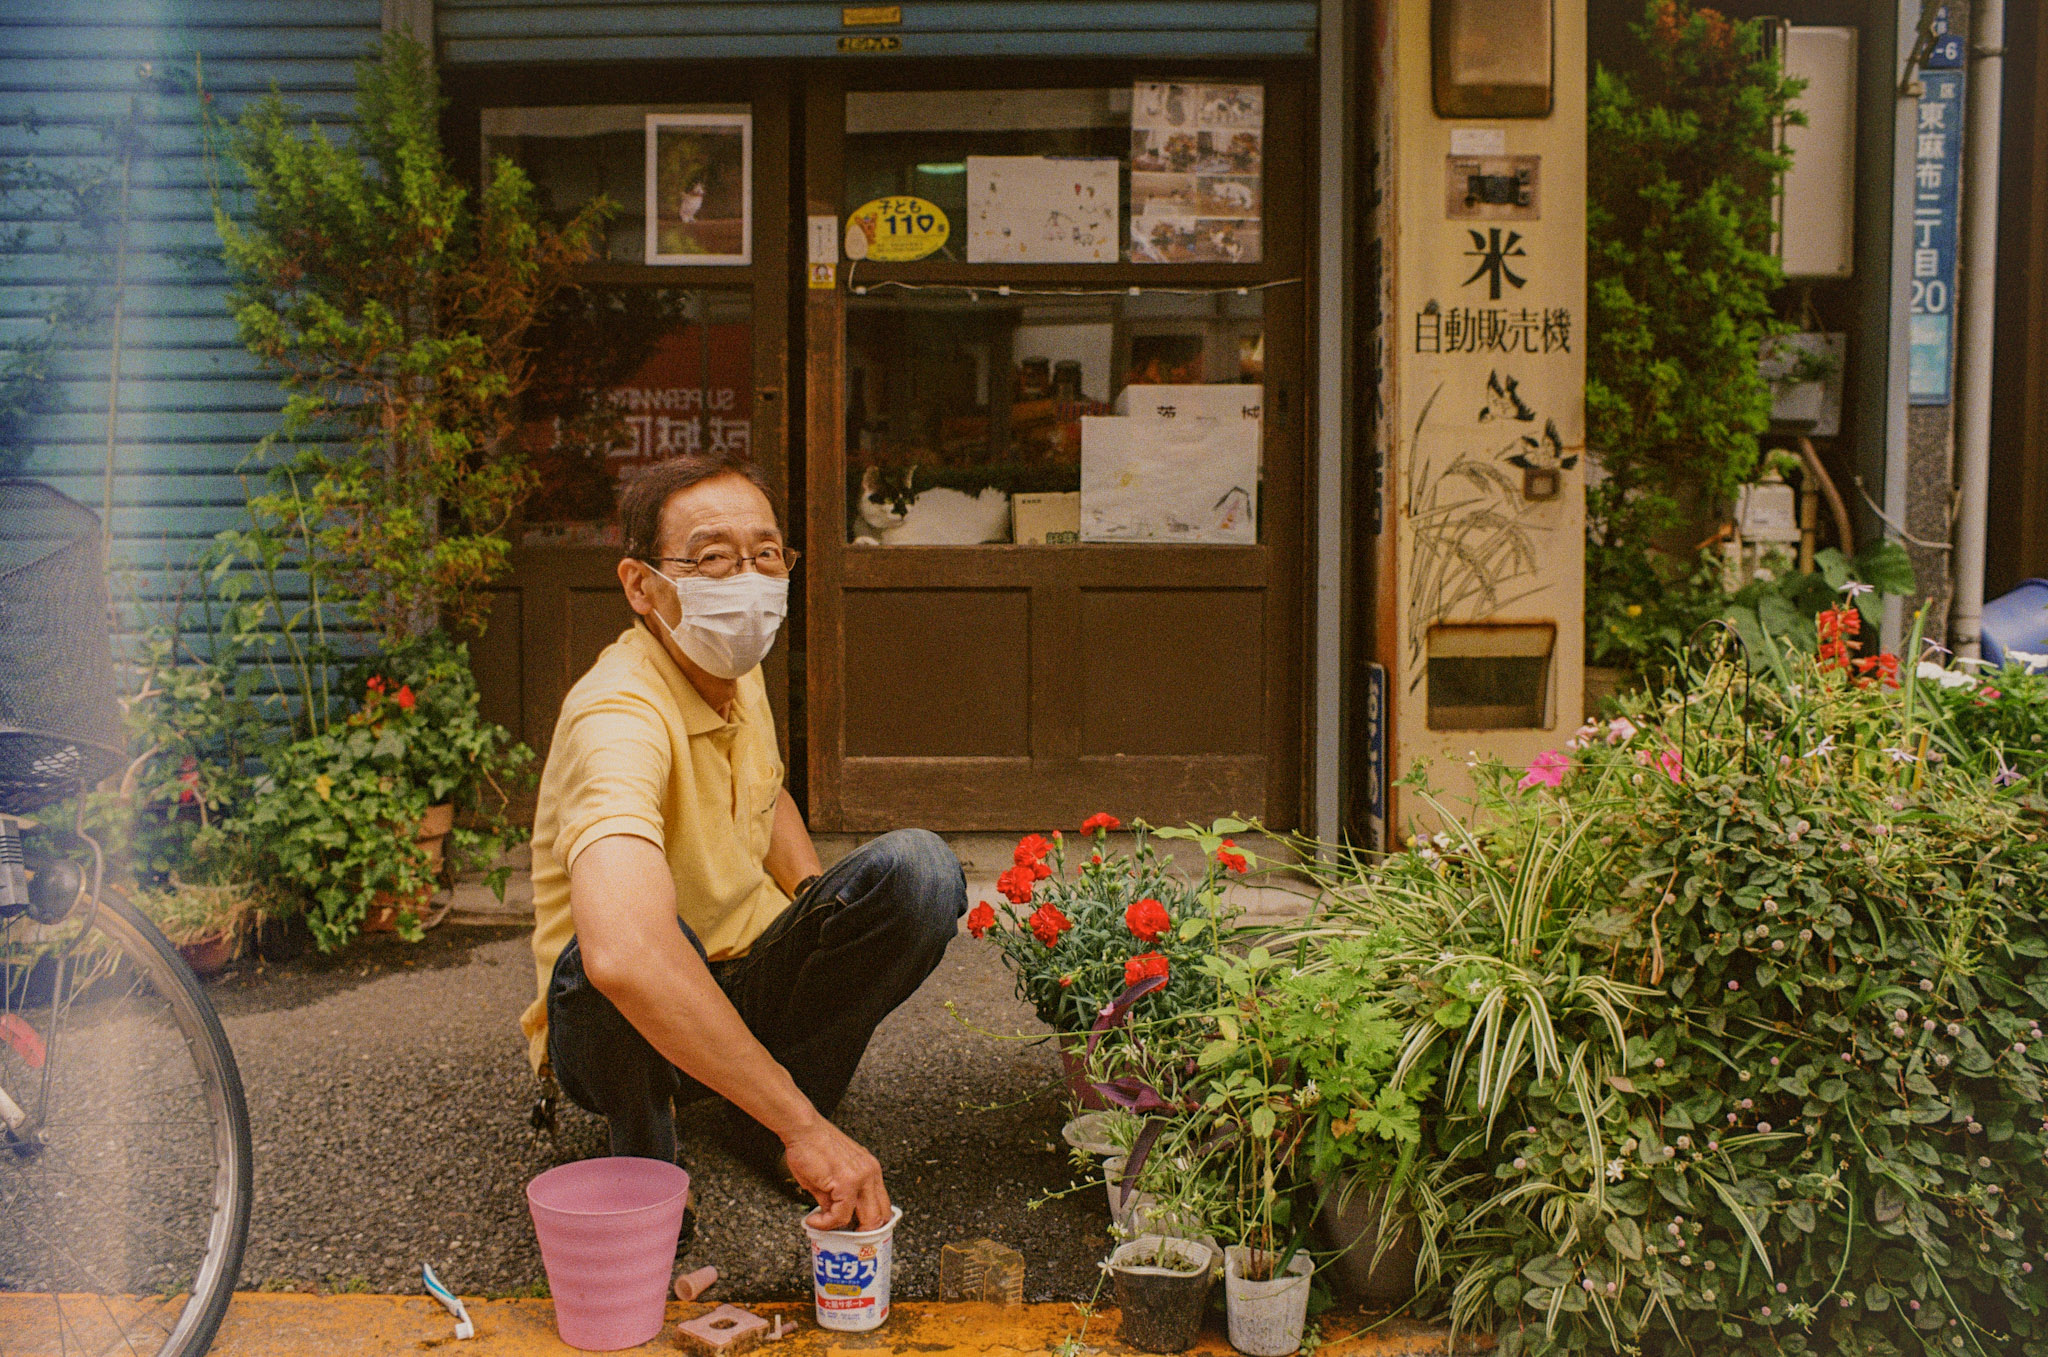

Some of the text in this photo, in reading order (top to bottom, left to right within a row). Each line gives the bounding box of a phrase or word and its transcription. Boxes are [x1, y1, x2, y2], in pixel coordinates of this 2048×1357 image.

[879, 200, 922, 215] 子ども
[1911, 103, 1947, 313] 東麻布二丁目 20
[1462, 228, 1527, 300] 米
[1415, 306, 1572, 354] 自動販売機
